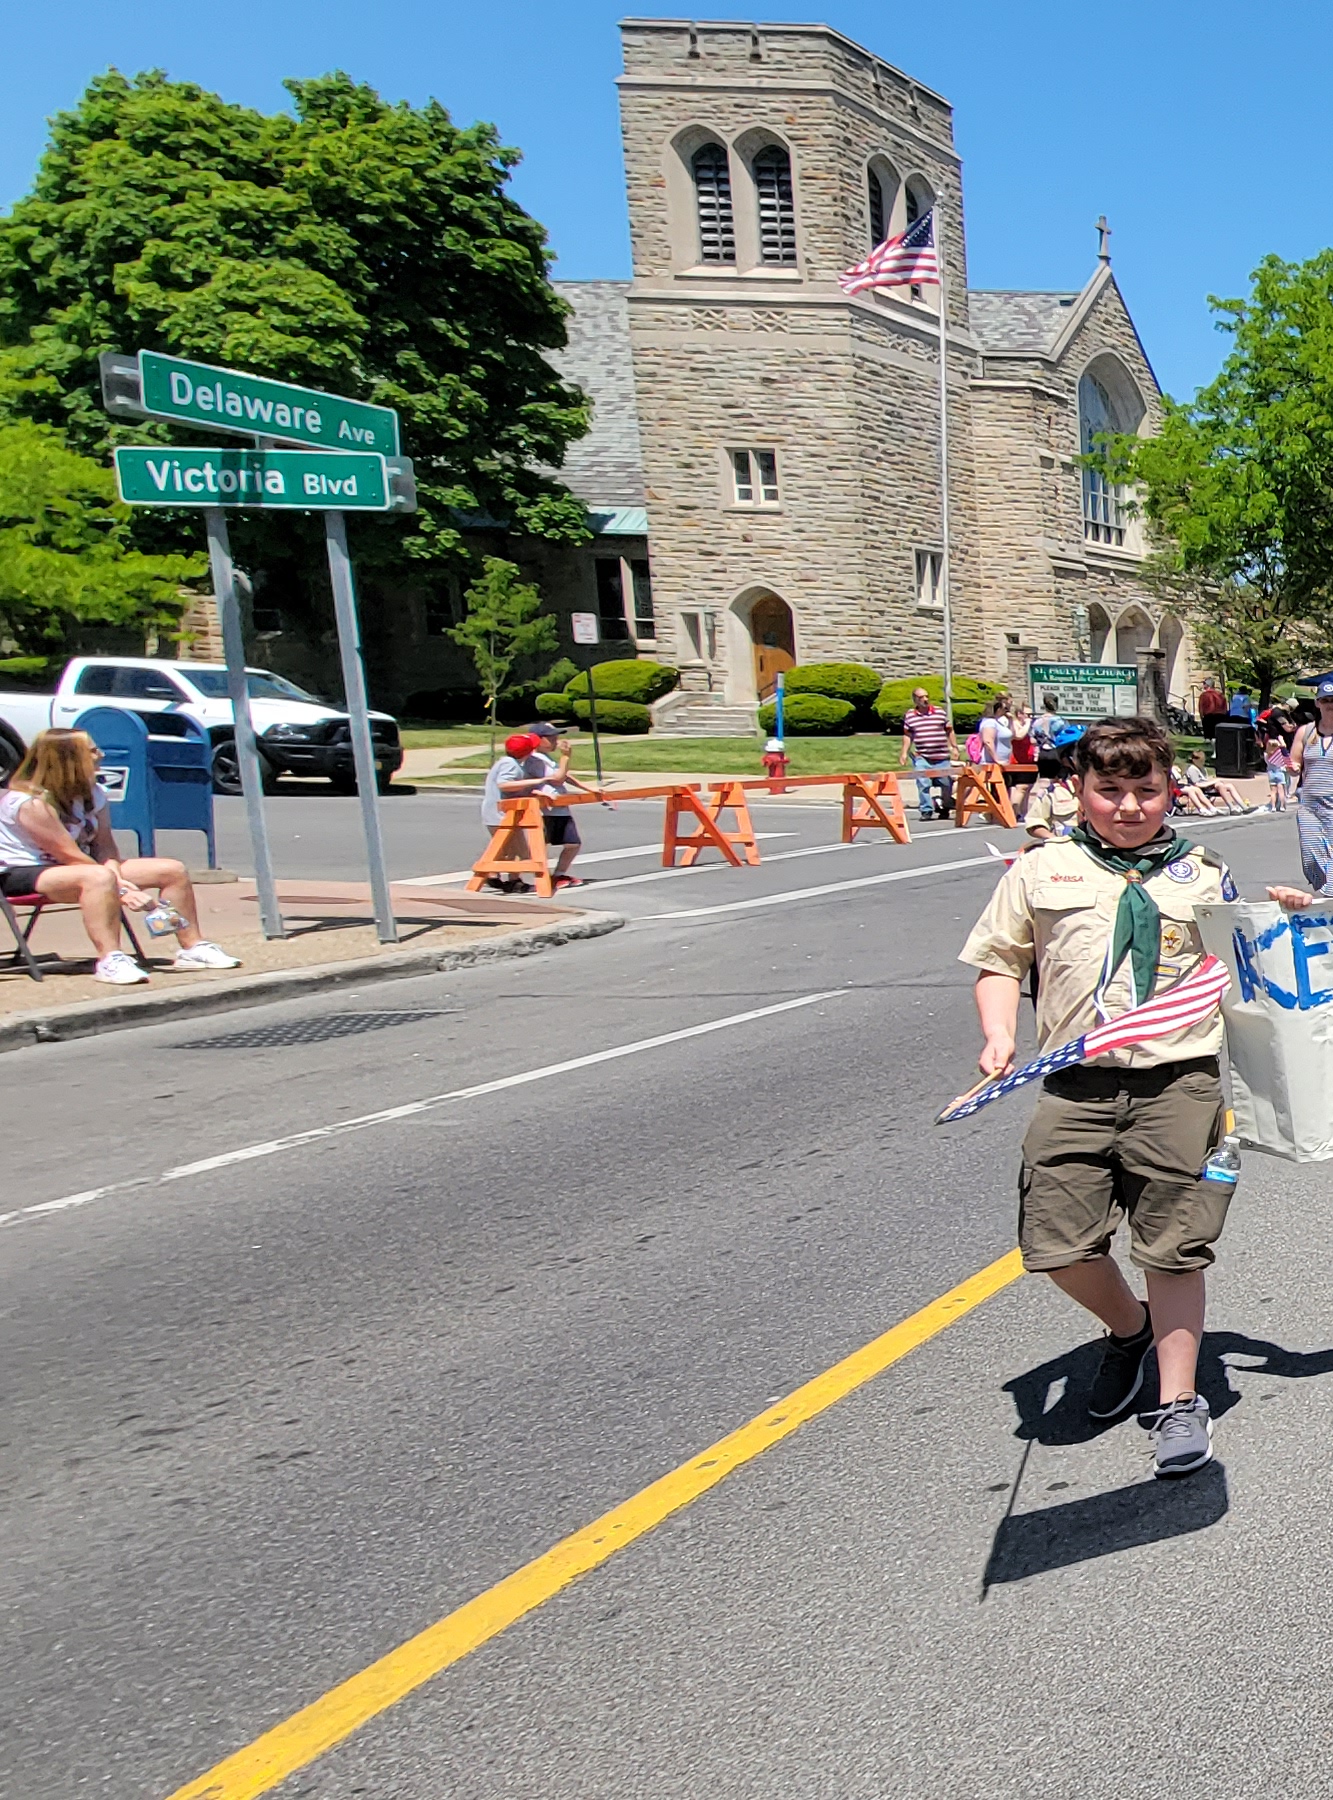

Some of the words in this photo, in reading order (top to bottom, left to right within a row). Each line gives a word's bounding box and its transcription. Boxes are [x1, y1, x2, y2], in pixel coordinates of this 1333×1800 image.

[170, 371, 322, 433] Delaware
[338, 420, 376, 445] Ave
[145, 459, 285, 495] Victoria
[303, 473, 357, 496] Blvd
